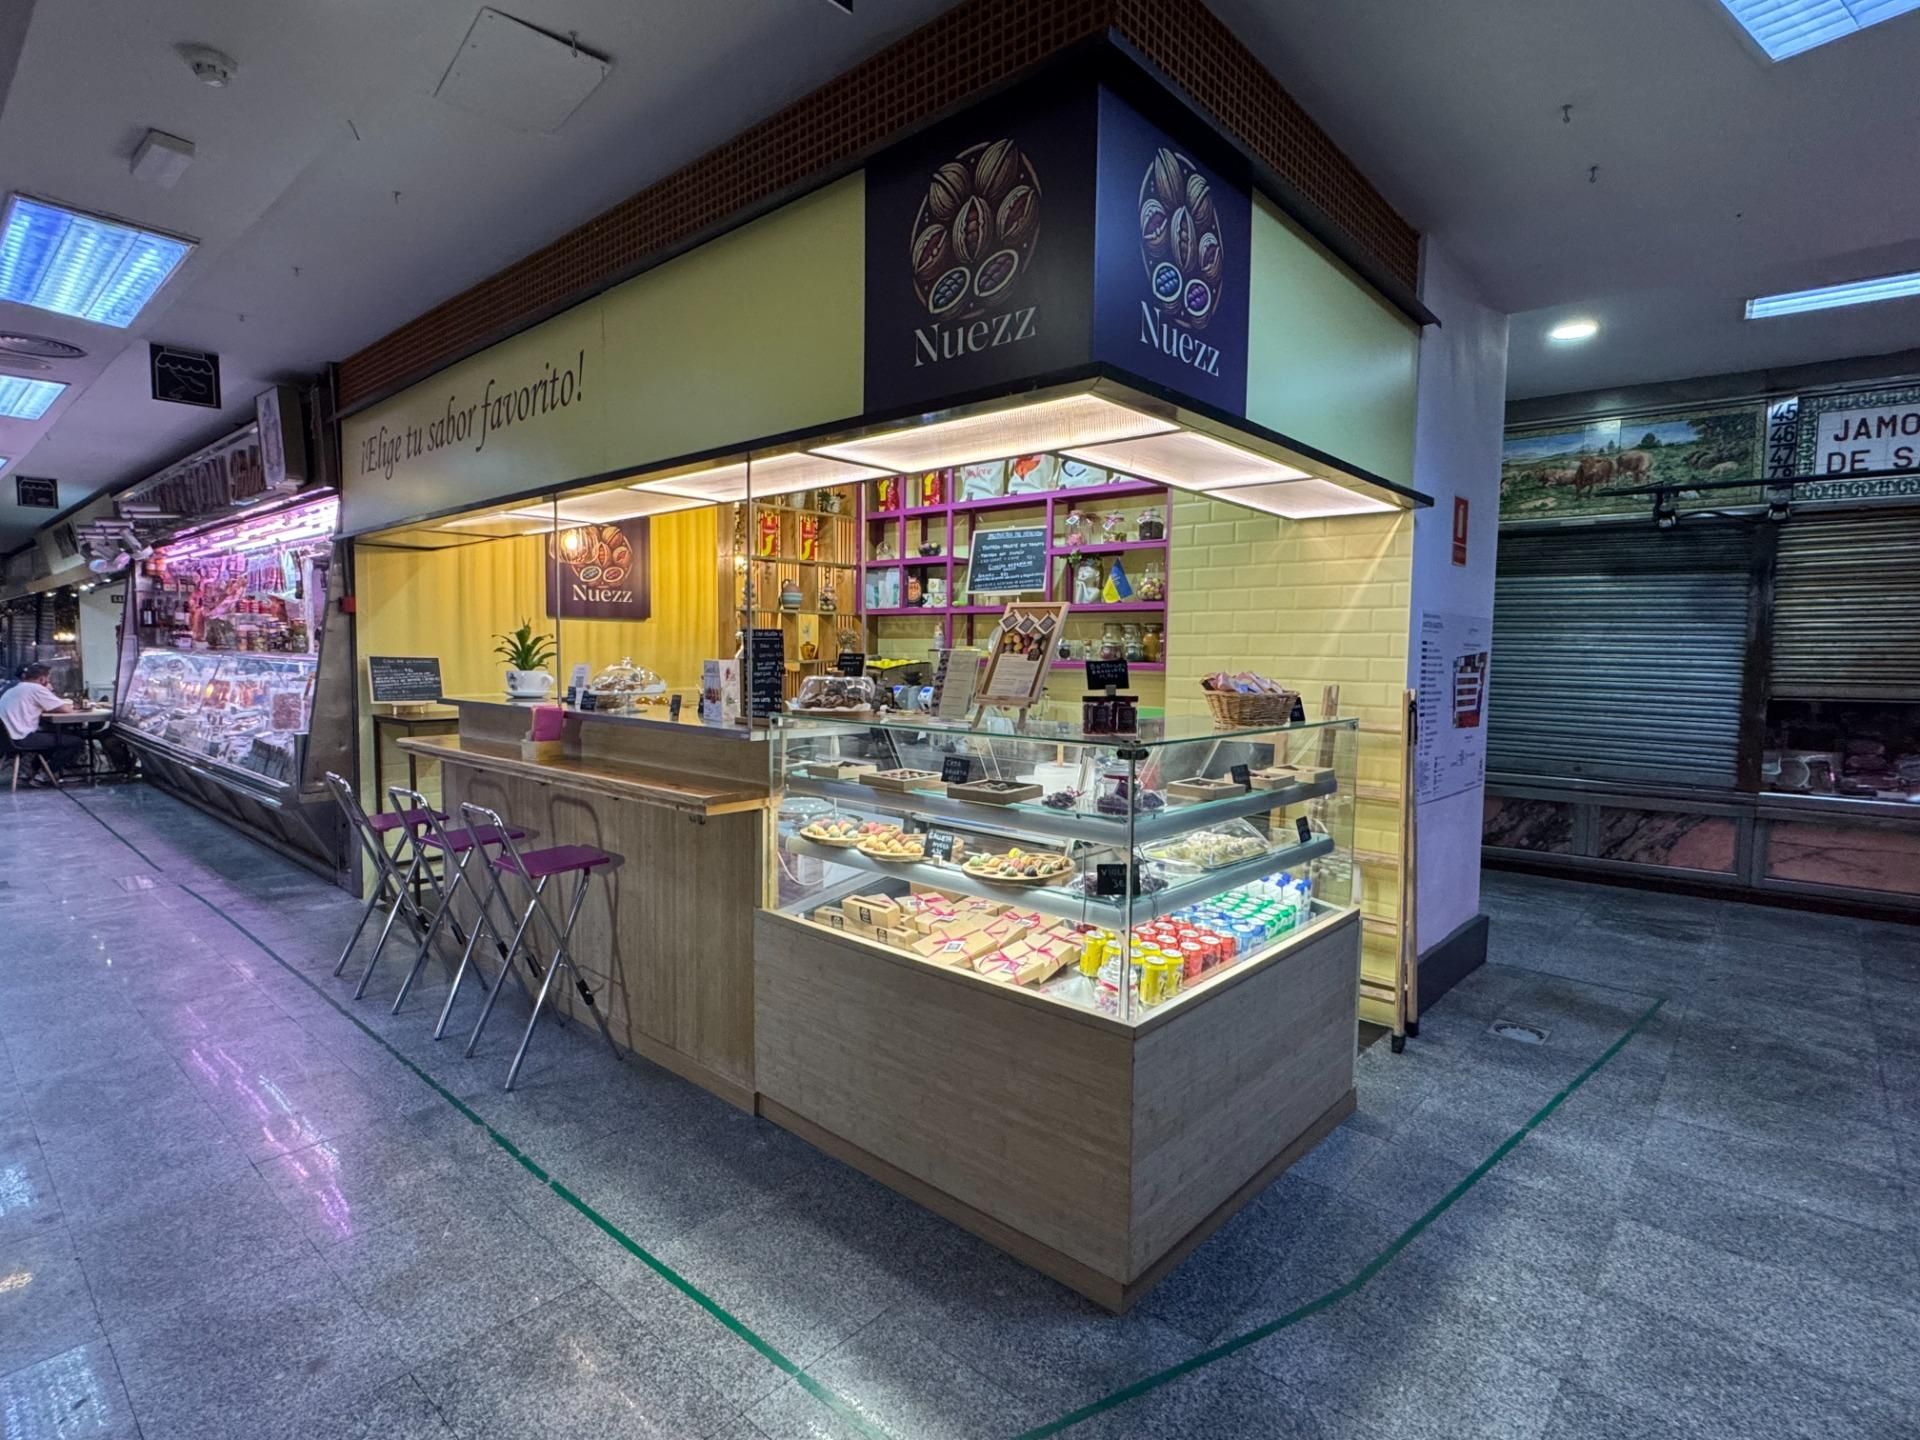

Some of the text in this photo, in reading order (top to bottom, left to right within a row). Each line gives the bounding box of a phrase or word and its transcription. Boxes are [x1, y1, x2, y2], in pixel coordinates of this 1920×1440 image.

[913, 305, 1037, 368] Nuezz
[1140, 299, 1220, 377] Nuezz
[361, 350, 584, 480] ¡Elige tu sabor favorito!
[1771, 403, 1798, 422] 45
[1769, 425, 1795, 443] 46
[1769, 446, 1794, 465] 47
[1826, 446, 1920, 475] DE S
[572, 584, 633, 603] Nuezz
